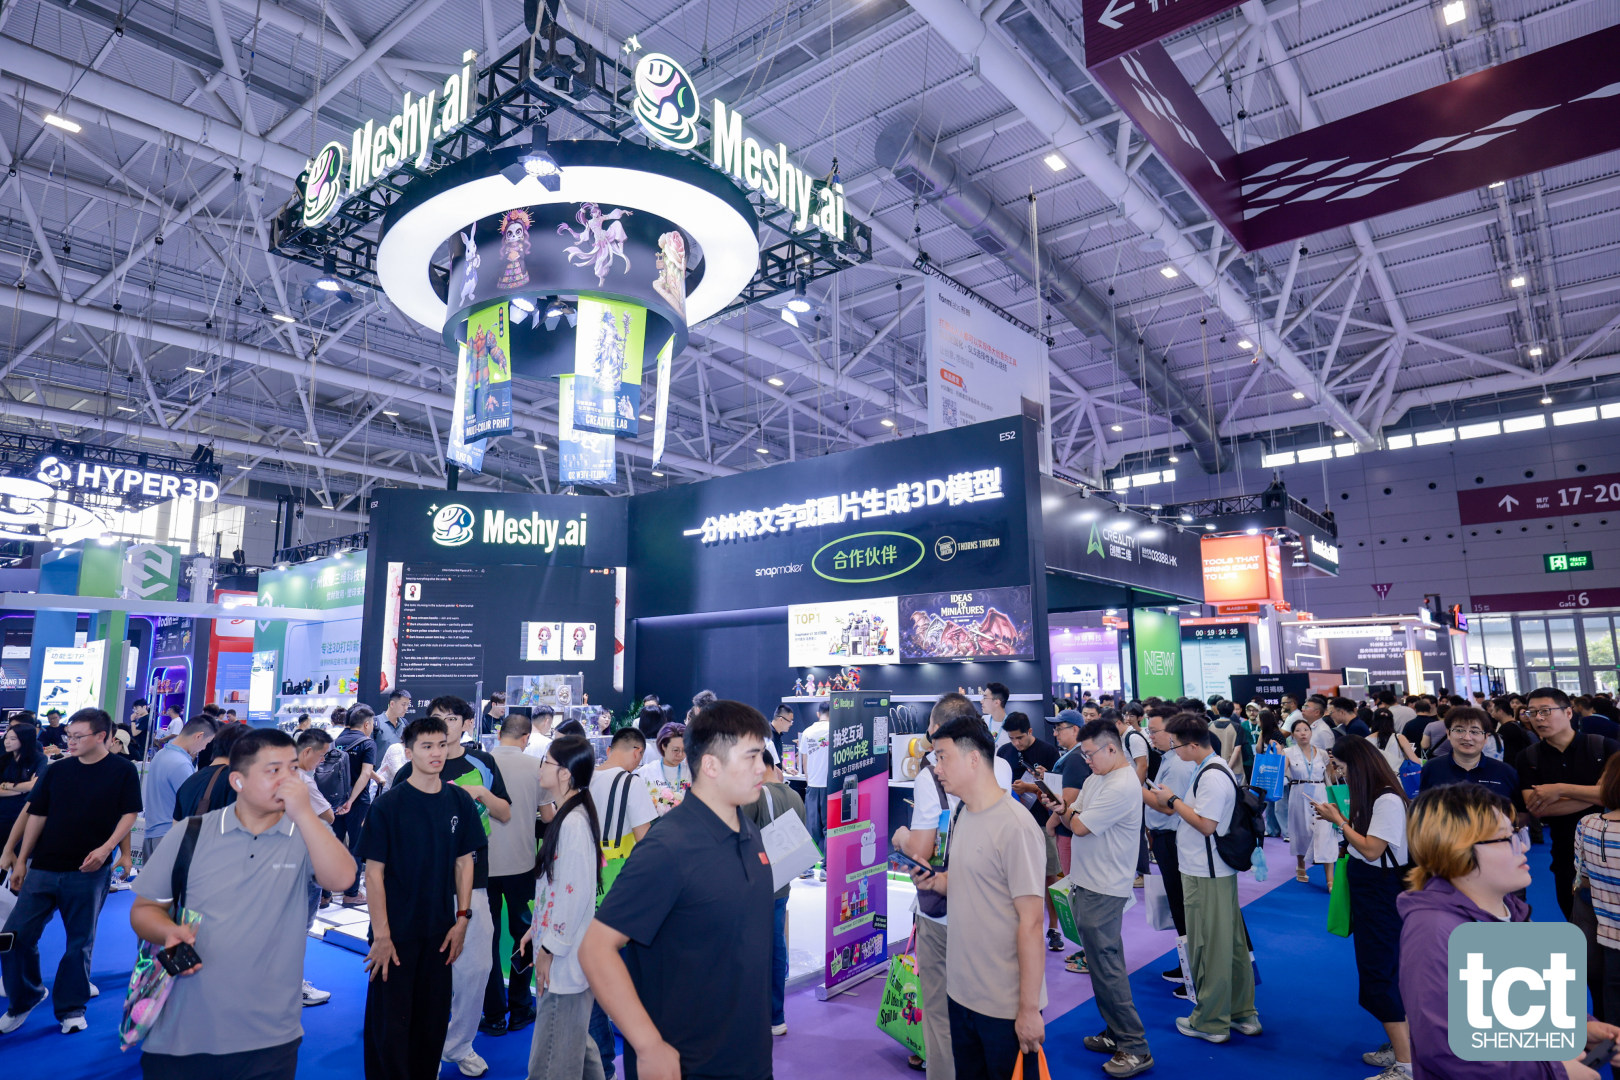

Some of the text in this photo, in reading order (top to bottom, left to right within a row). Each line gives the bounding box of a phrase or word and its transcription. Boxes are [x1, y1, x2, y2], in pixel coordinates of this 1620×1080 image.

[349, 49, 477, 194] Meshy.ai
[710, 98, 845, 241] Meshy.ai
[492, 417, 510, 429] PRINT
[585, 414, 628, 429] CREATIVE LAB
[999, 430, 1016, 442] E52
[77, 462, 219, 503] HYPER3D
[683, 467, 1004, 543] 一分钟将文字或图片生成3D模型
[483, 509, 588, 553] Meshy.ai
[1102, 528, 1135, 549] CREALITY
[833, 544, 898, 570] 合作伙伴
[1203, 554, 1260, 566] TOOLS THAT
[1232, 562, 1259, 571] IDEAS
[755, 562, 803, 578] snapmaker
[950, 593, 973, 603] IDEAS
[1578, 592, 1590, 606] 6
[940, 605, 985, 617] MINIATURES
[1143, 650, 1176, 676] NEW
[833, 722, 864, 748] 抽奖互动
[833, 739, 869, 766] 100%中奖
